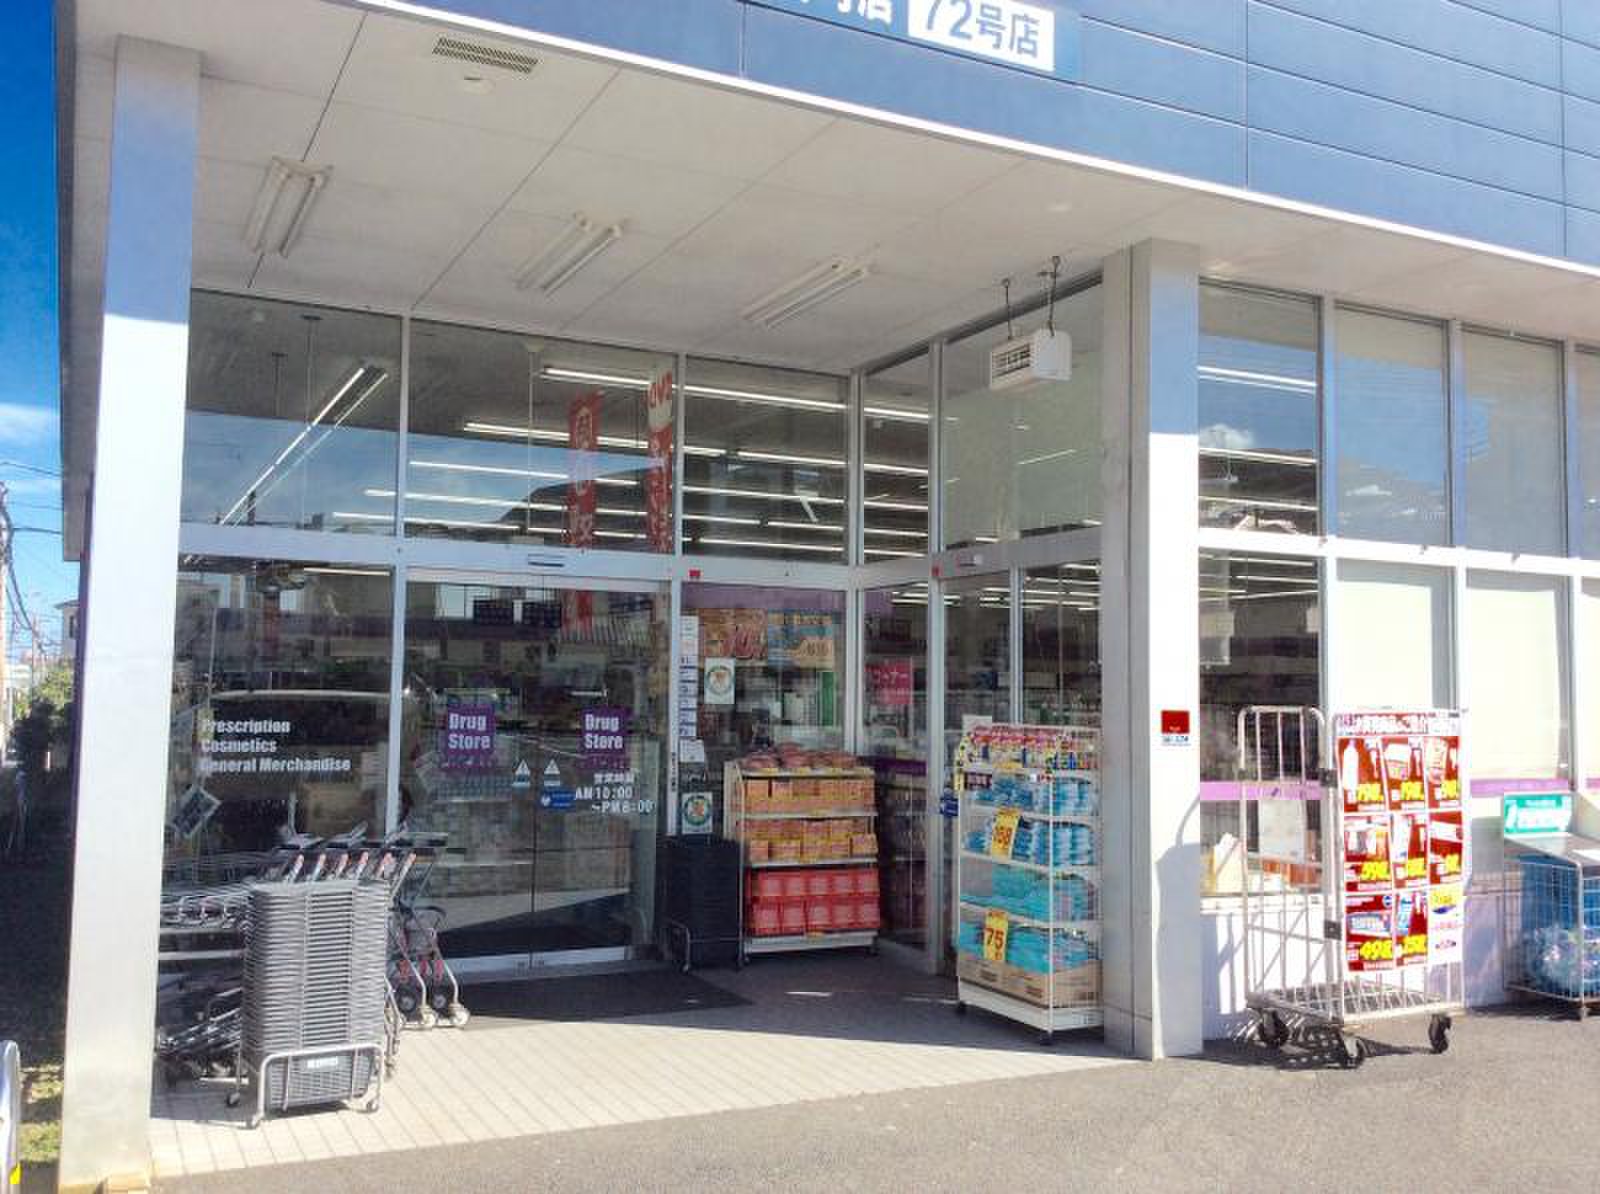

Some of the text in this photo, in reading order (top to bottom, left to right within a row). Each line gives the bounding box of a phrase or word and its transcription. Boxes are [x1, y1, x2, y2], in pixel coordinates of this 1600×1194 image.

[926, 0, 1039, 58] 72号店
[449, 712, 487, 733] Drug
[585, 713, 620, 734] Drug
[448, 733, 491, 750] Store
[584, 733, 623, 750] Store
[259, 757, 351, 772] Merchandise
